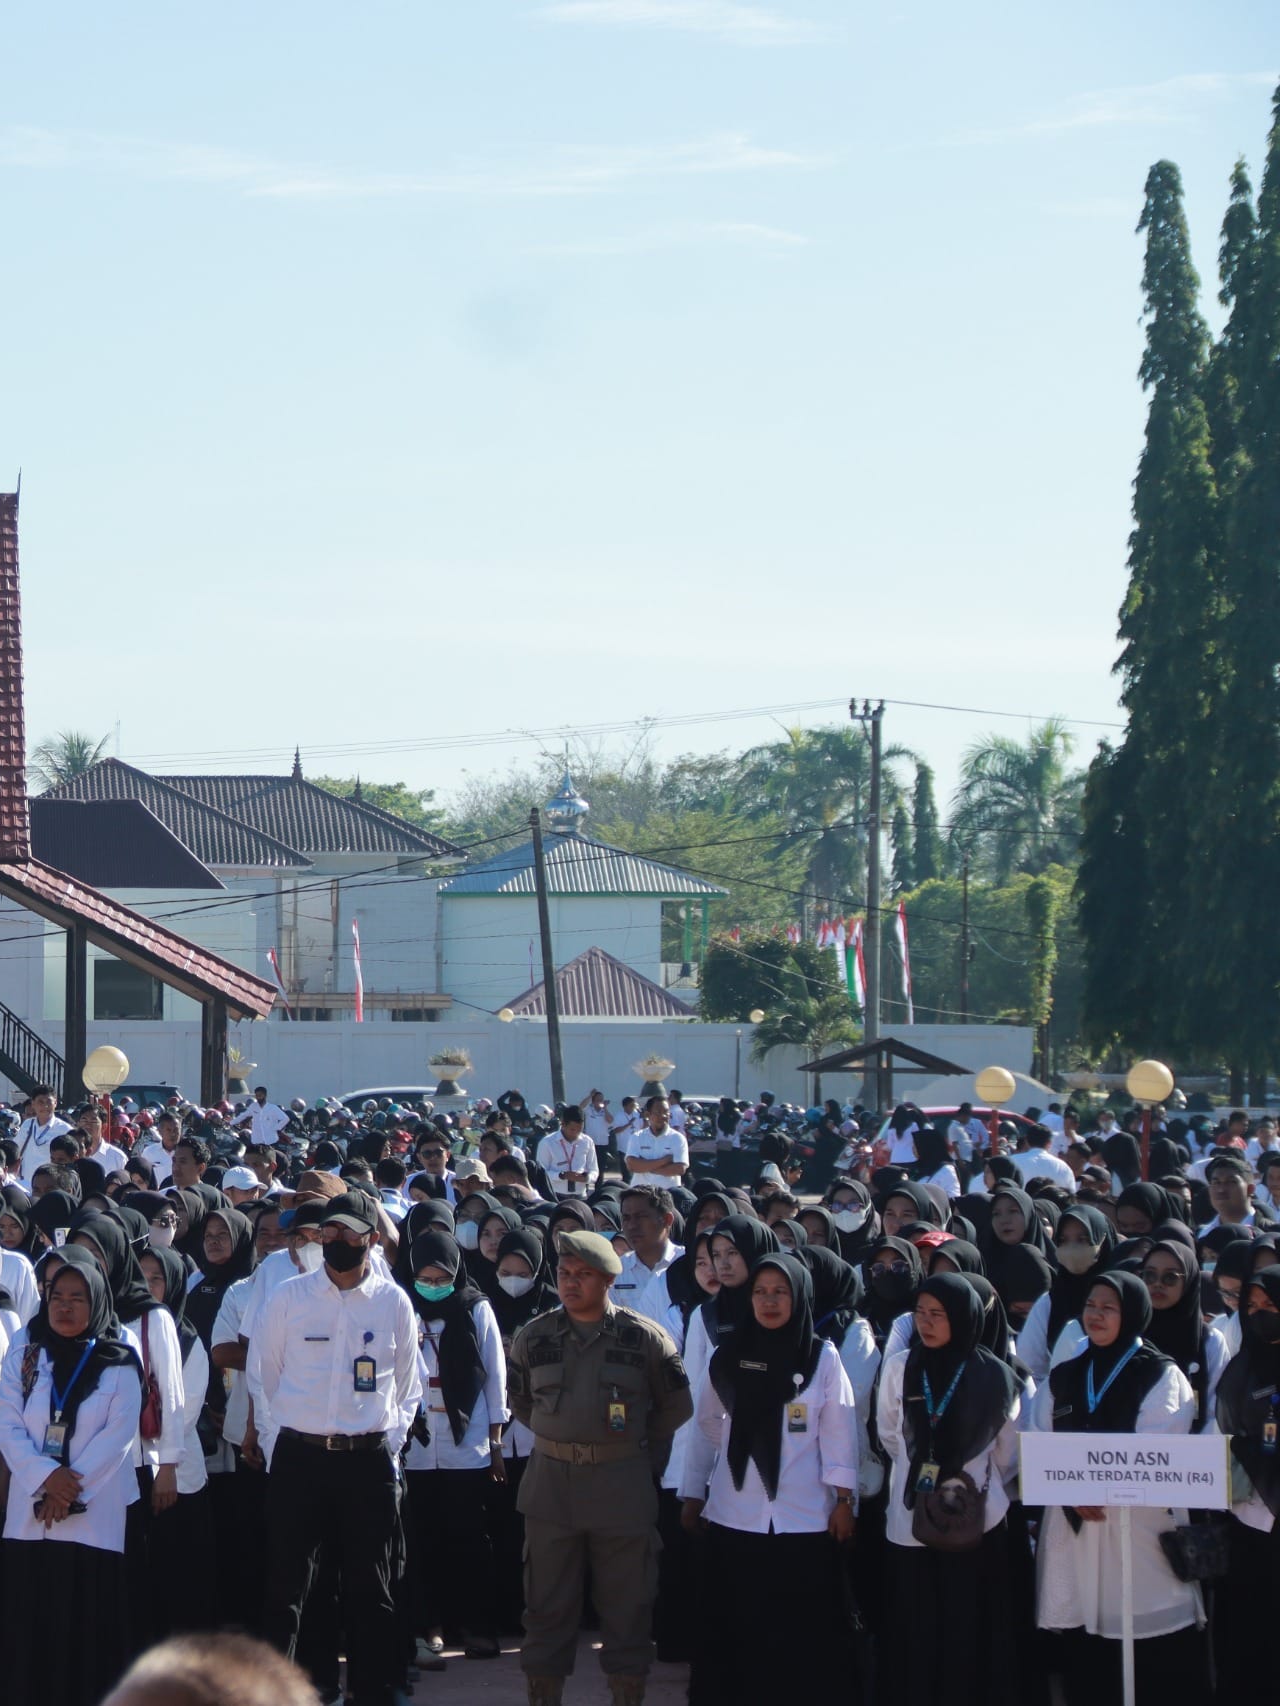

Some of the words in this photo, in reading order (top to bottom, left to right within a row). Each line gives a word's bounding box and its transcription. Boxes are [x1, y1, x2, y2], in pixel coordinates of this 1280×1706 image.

[1087, 1451, 1128, 1465] NON
[1134, 1452, 1170, 1466] ASN
[1045, 1470, 1085, 1481] TIDAK
[1089, 1470, 1151, 1482] TERDATA
[1155, 1471, 1183, 1483] BKN
[1187, 1471, 1214, 1485] (R4)
